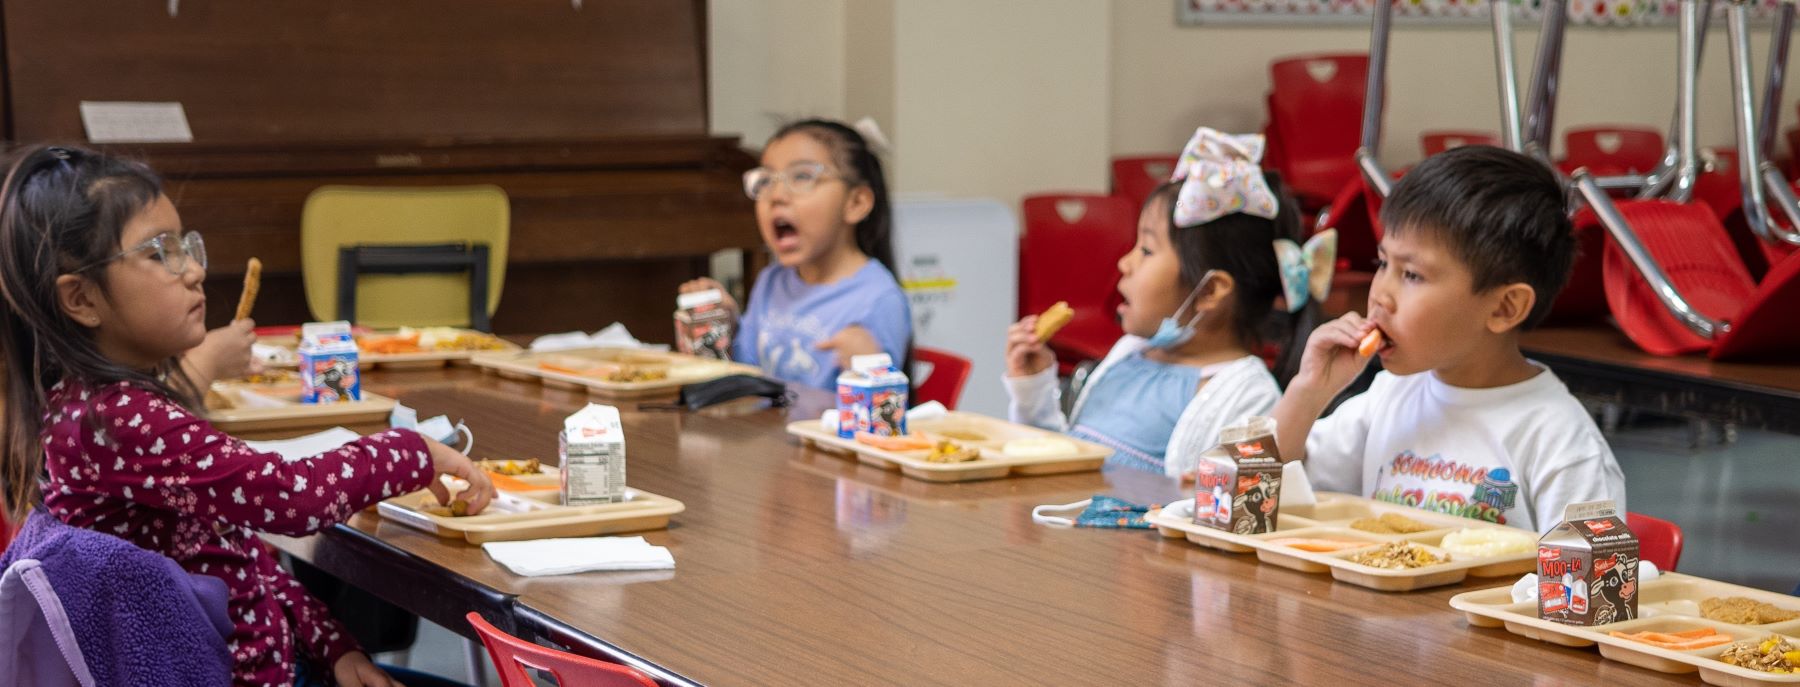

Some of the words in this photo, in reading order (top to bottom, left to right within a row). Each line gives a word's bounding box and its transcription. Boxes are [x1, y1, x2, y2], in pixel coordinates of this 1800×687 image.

[1391, 450, 1488, 485] someone
[1423, 488, 1500, 524] loves
[1592, 535, 1618, 543] chocolate
